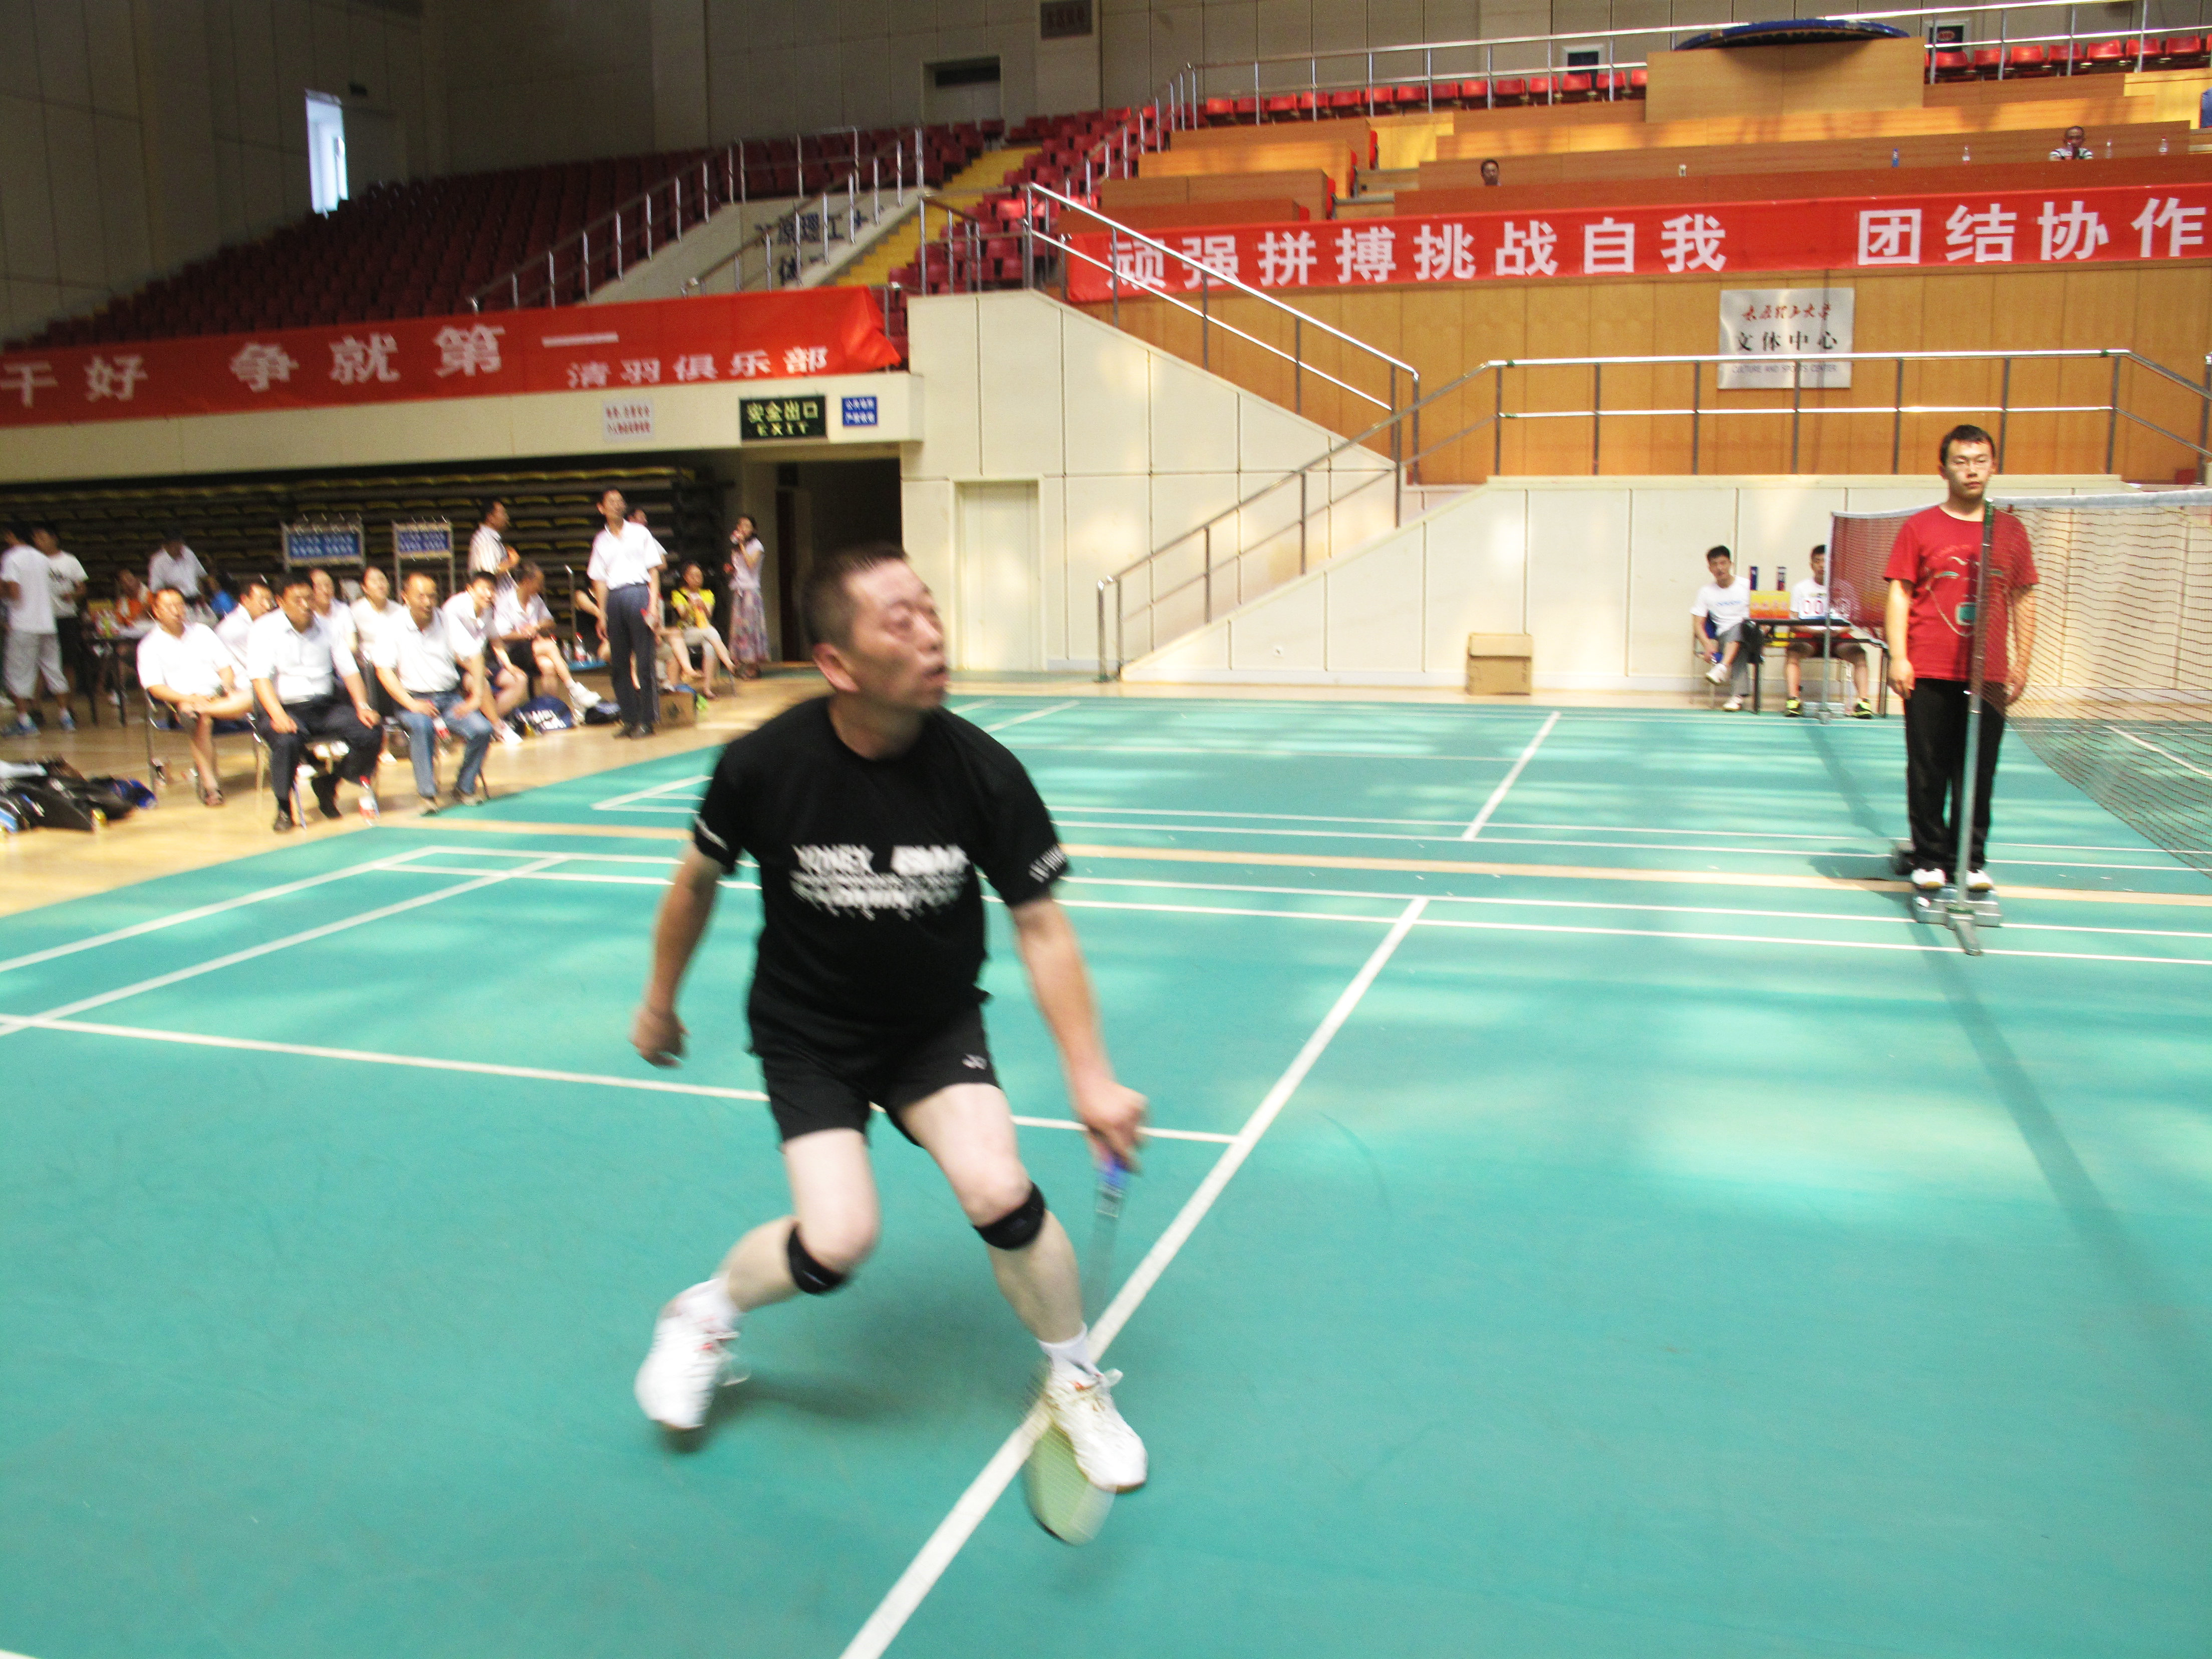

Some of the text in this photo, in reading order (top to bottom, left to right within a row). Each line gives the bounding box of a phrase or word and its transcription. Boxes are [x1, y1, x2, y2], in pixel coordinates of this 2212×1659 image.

[1107, 197, 2206, 290] 顽强拼搏挑战自我 团结协作
[1738, 330, 1838, 351] 文体中心
[0, 323, 619, 407] 干好 争就第一
[746, 399, 819, 424] 安全出口
[756, 420, 809, 437] EXIT
